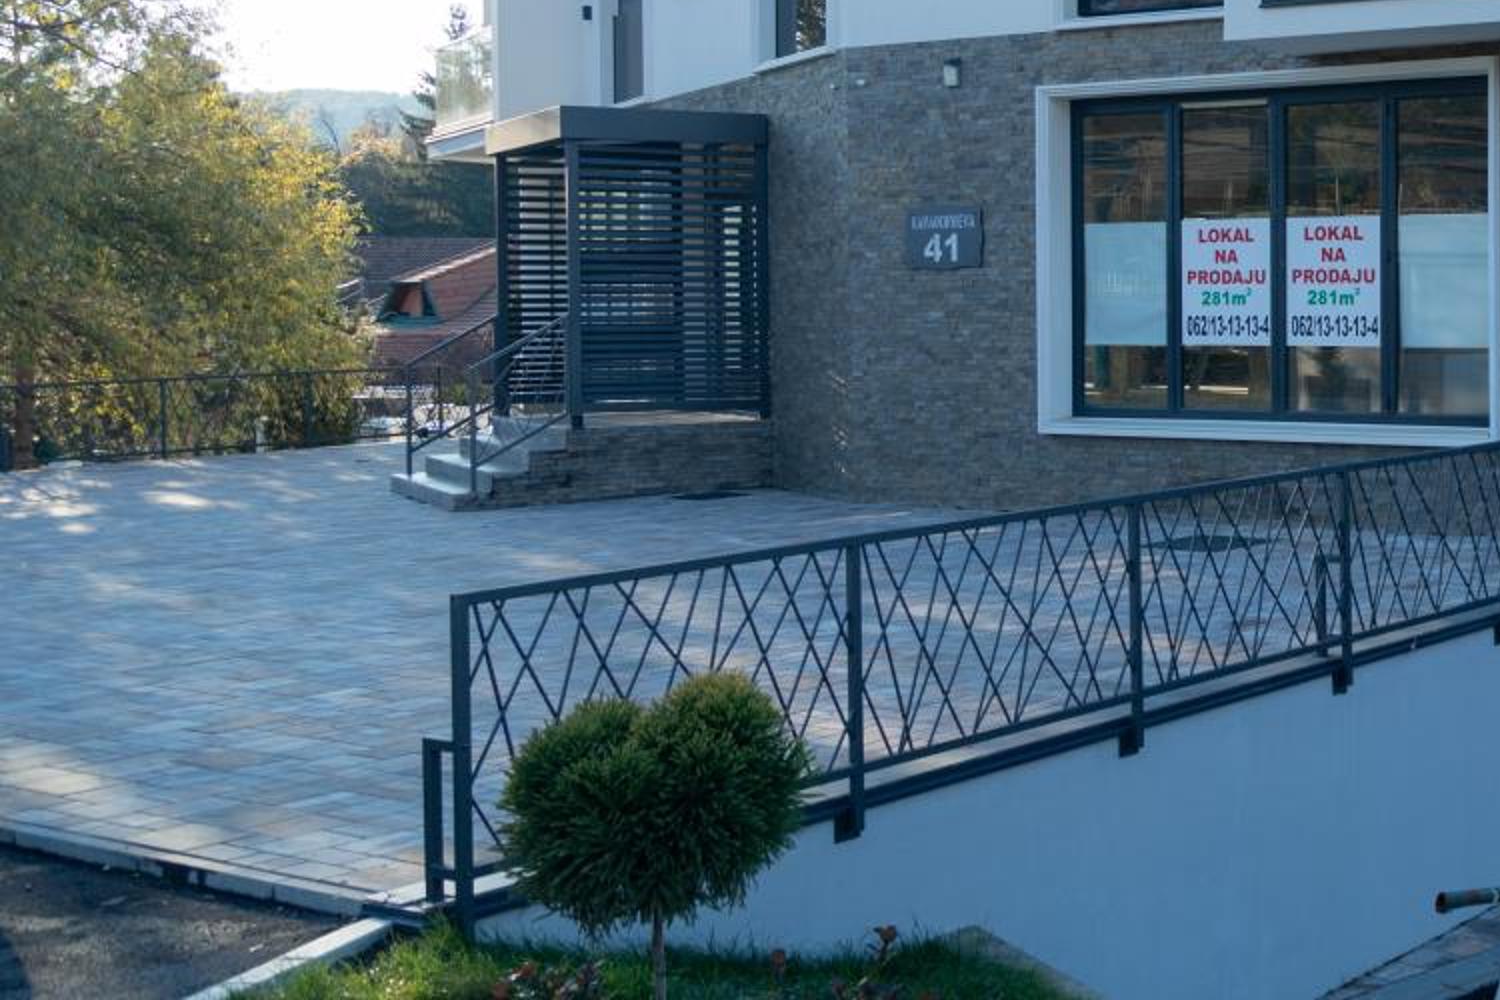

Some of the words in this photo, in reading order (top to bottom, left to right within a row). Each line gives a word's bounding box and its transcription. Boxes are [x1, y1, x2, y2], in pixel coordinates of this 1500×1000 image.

[1198, 228, 1254, 243] LOKAL
[1304, 226, 1364, 242] LOKAL
[923, 233, 959, 263] 41
[1321, 247, 1346, 263] NA
[1214, 249, 1238, 264] NA
[1187, 269, 1266, 285] PRODAJU
[1292, 268, 1376, 284] PRODAJU
